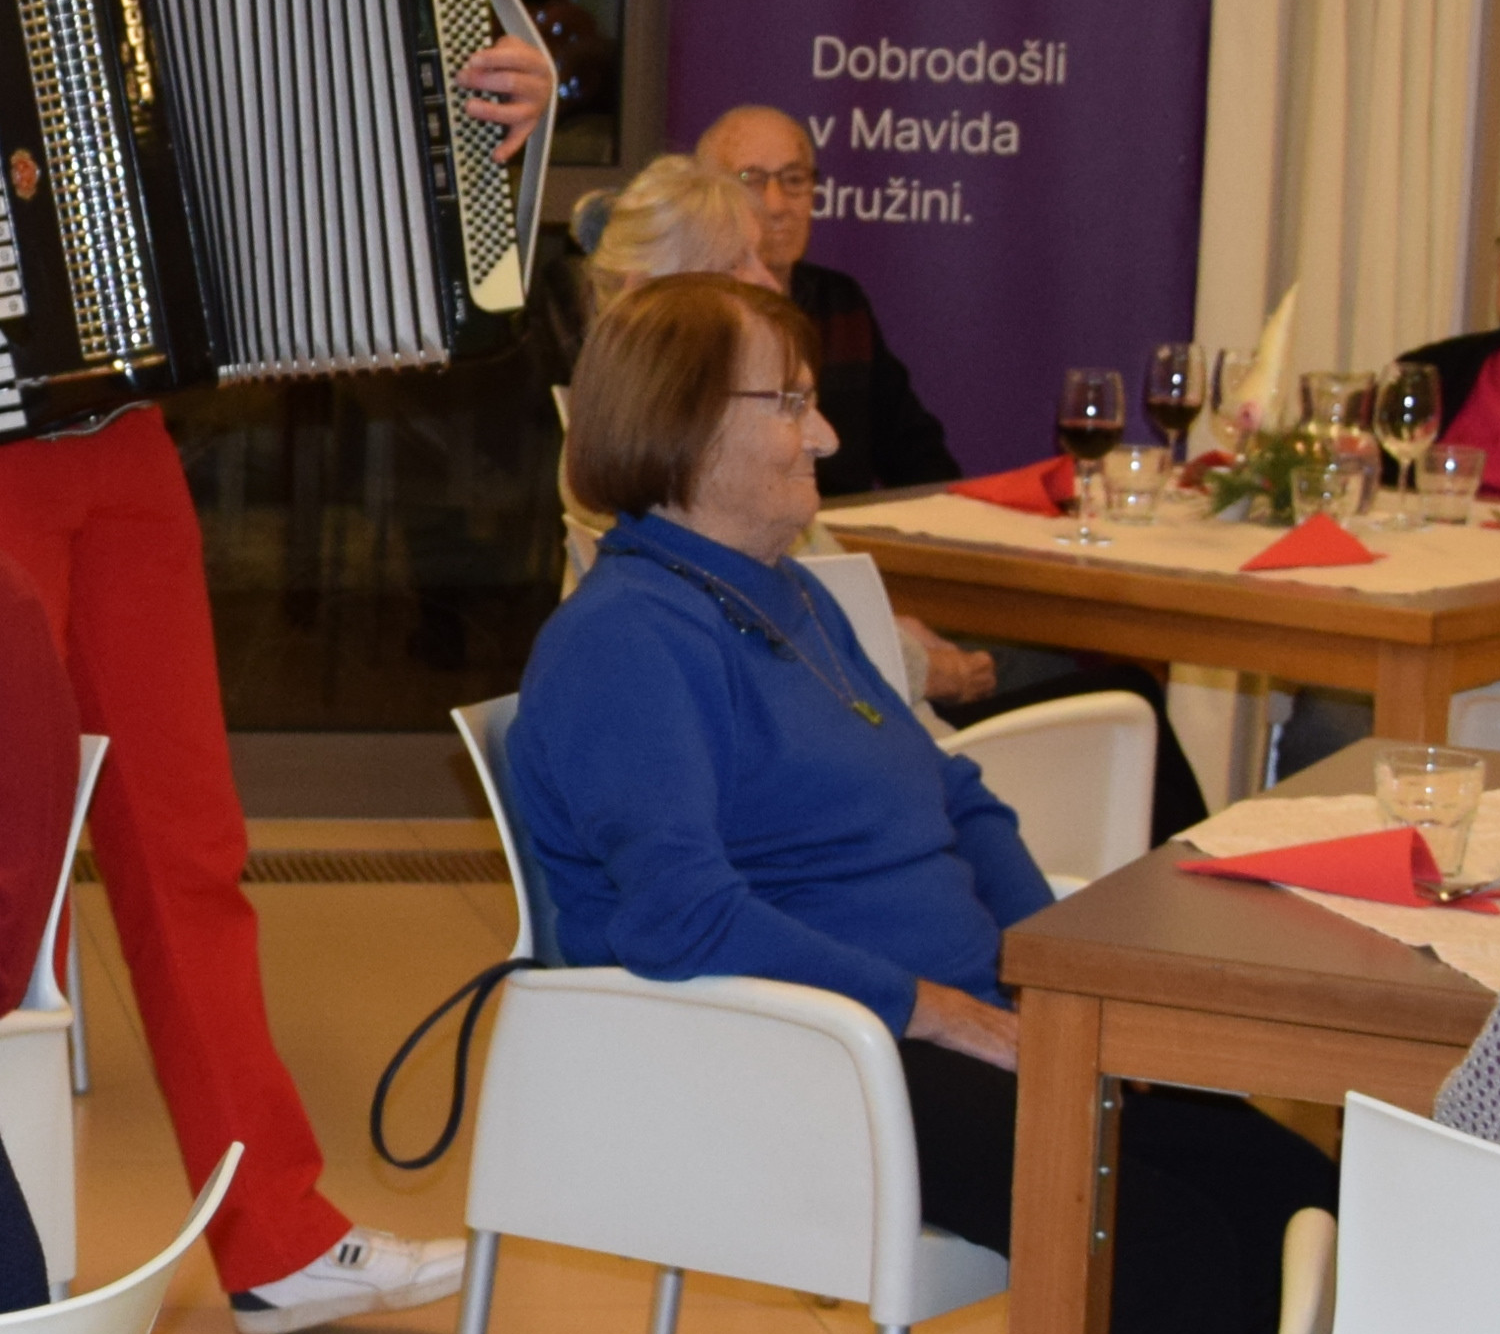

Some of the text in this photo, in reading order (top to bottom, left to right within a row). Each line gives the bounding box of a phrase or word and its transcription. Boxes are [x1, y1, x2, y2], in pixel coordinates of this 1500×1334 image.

[811, 34, 1067, 85] Dobrodošli
[808, 107, 1020, 155] v Mavida
[811, 177, 974, 224] družini.
